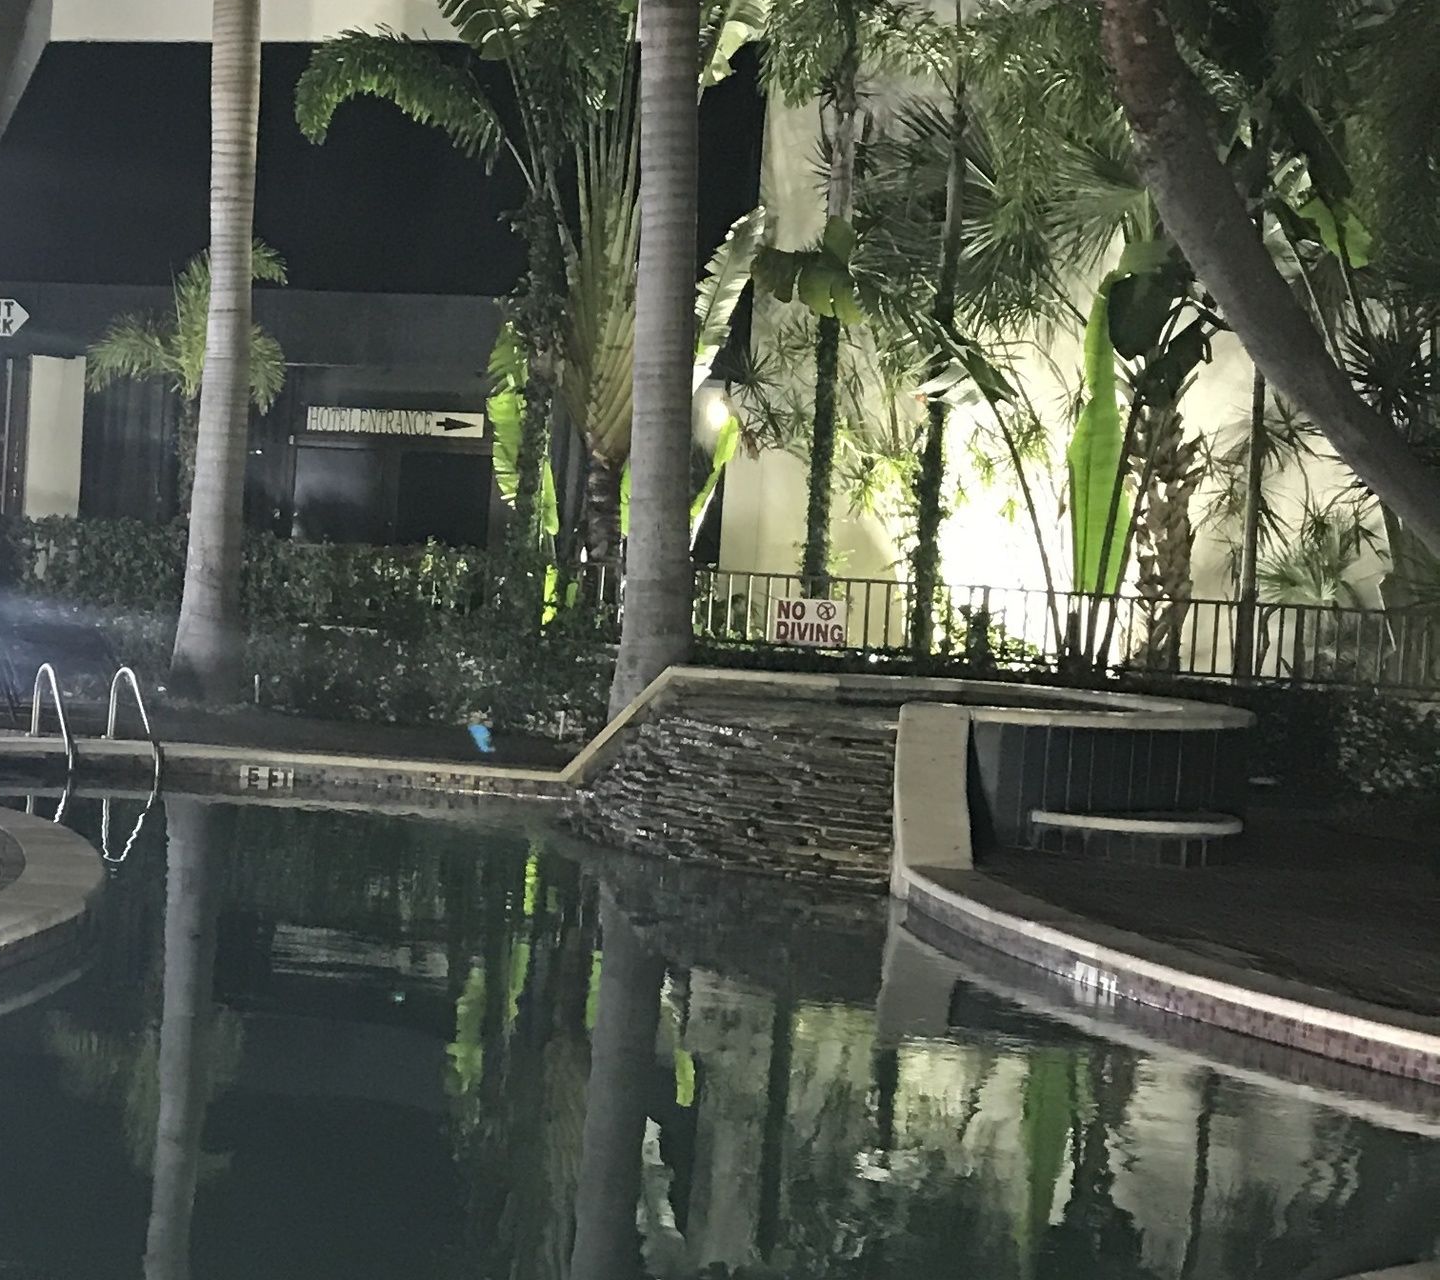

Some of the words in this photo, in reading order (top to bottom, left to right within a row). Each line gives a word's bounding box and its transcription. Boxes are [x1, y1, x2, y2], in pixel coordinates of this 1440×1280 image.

[308, 406, 358, 433] HOTEL
[360, 409, 433, 436] ENTRANCE
[777, 600, 806, 620] NO
[775, 621, 844, 643] DIVING
